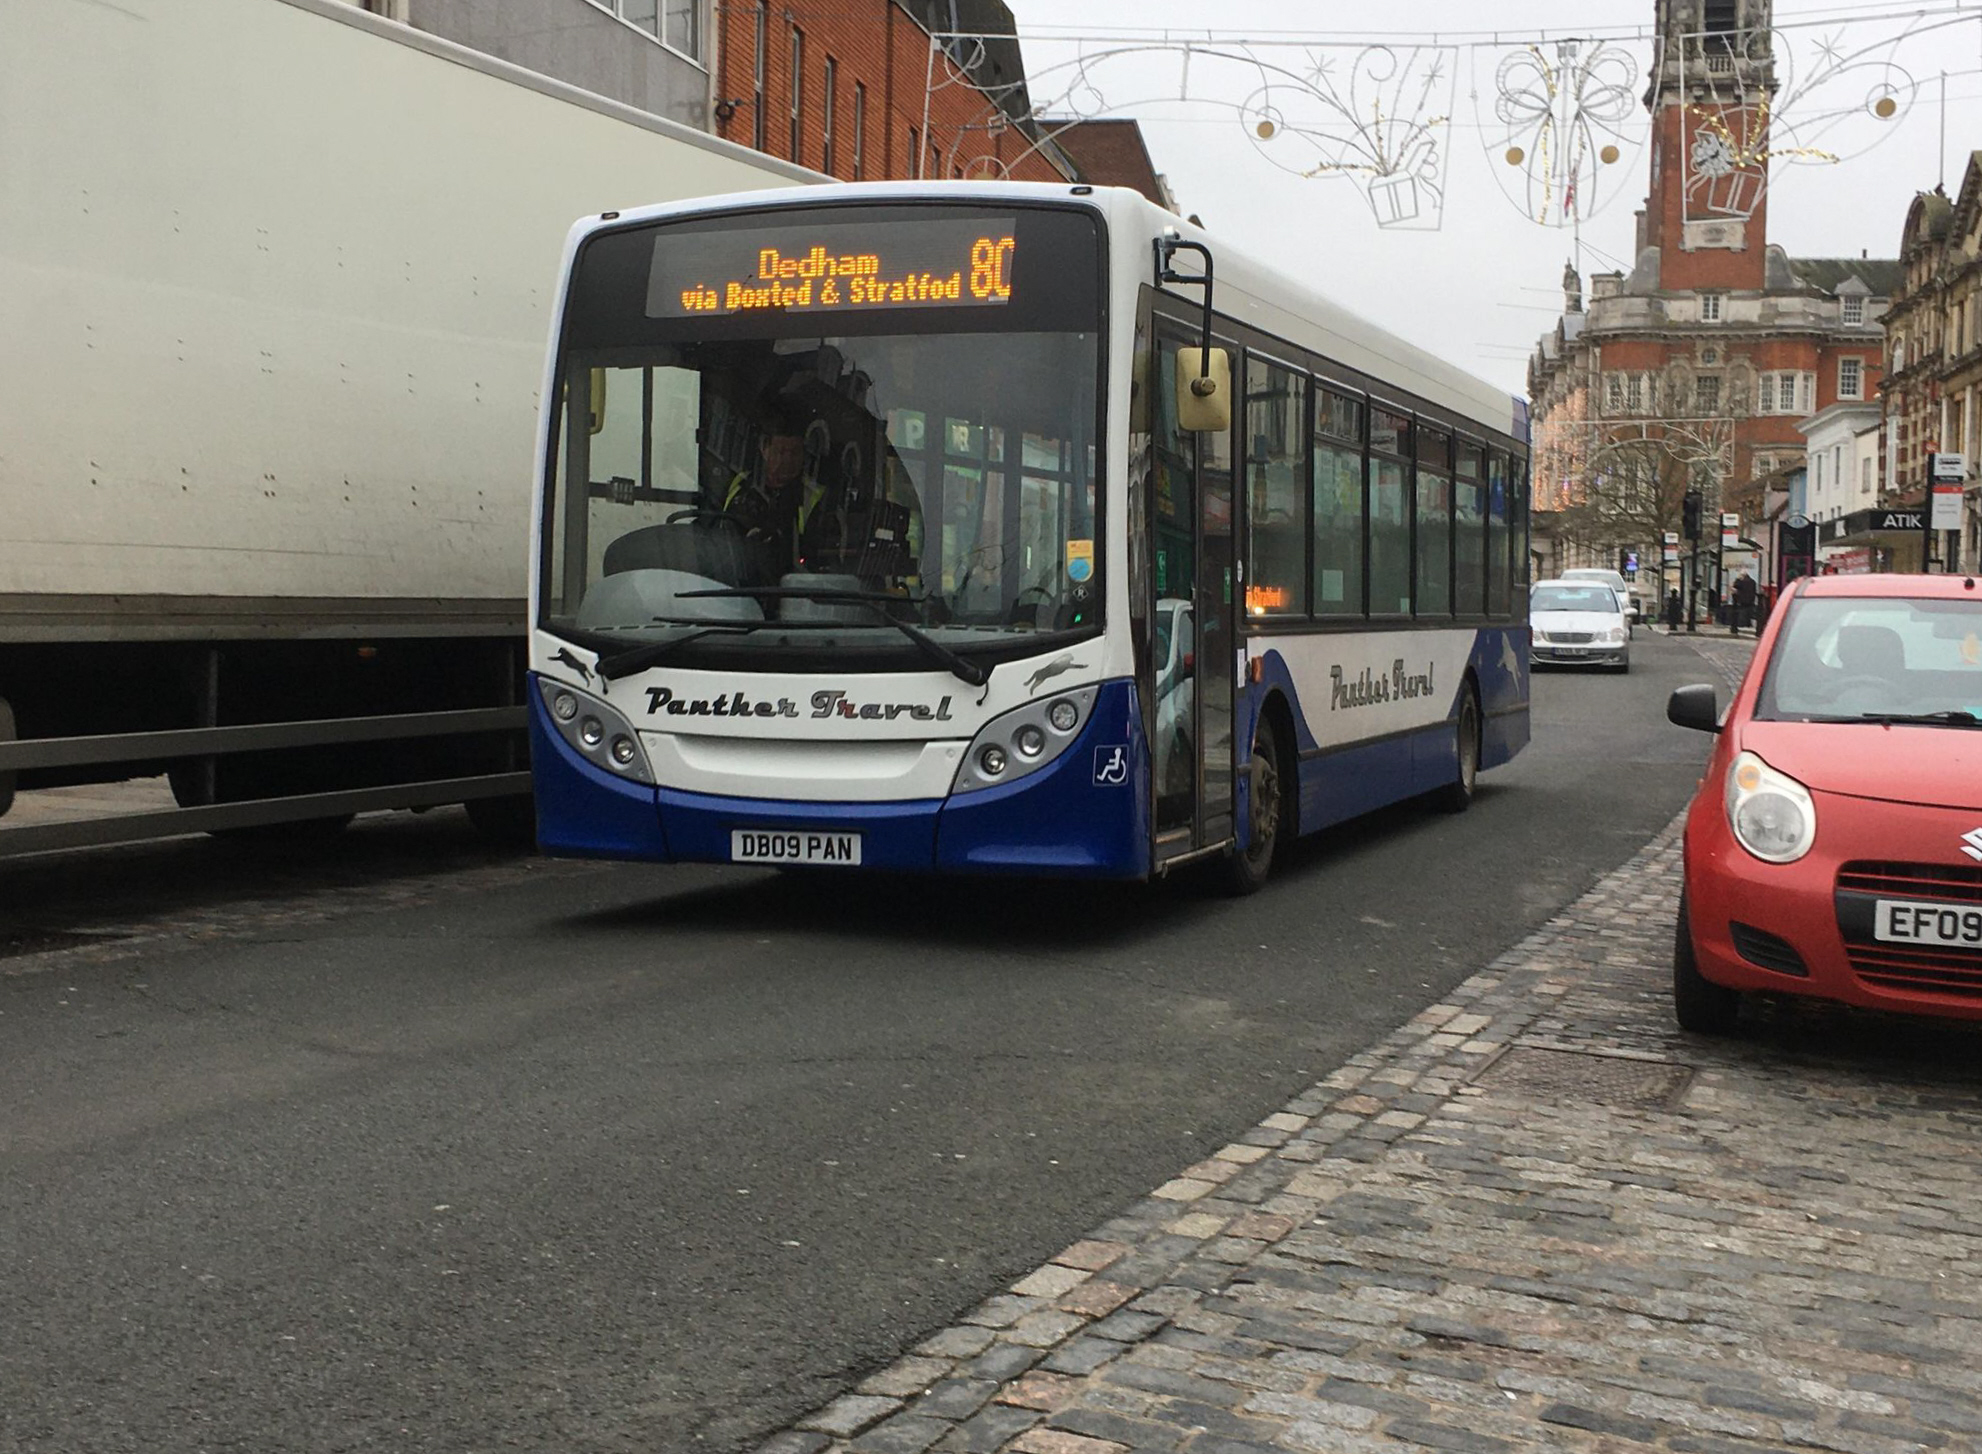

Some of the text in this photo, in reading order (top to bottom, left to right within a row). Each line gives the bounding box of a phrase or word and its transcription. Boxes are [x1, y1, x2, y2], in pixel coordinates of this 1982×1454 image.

[759, 246, 879, 279] Dedham
[681, 272, 961, 310] via Boxted & Stratfod
[1882, 513, 1923, 528] ATIK
[1330, 658, 1434, 711] Panther Travel
[645, 687, 953, 721] Panther Travel
[741, 834, 852, 860] DB09 PAN
[1889, 906, 1982, 942] EF09
